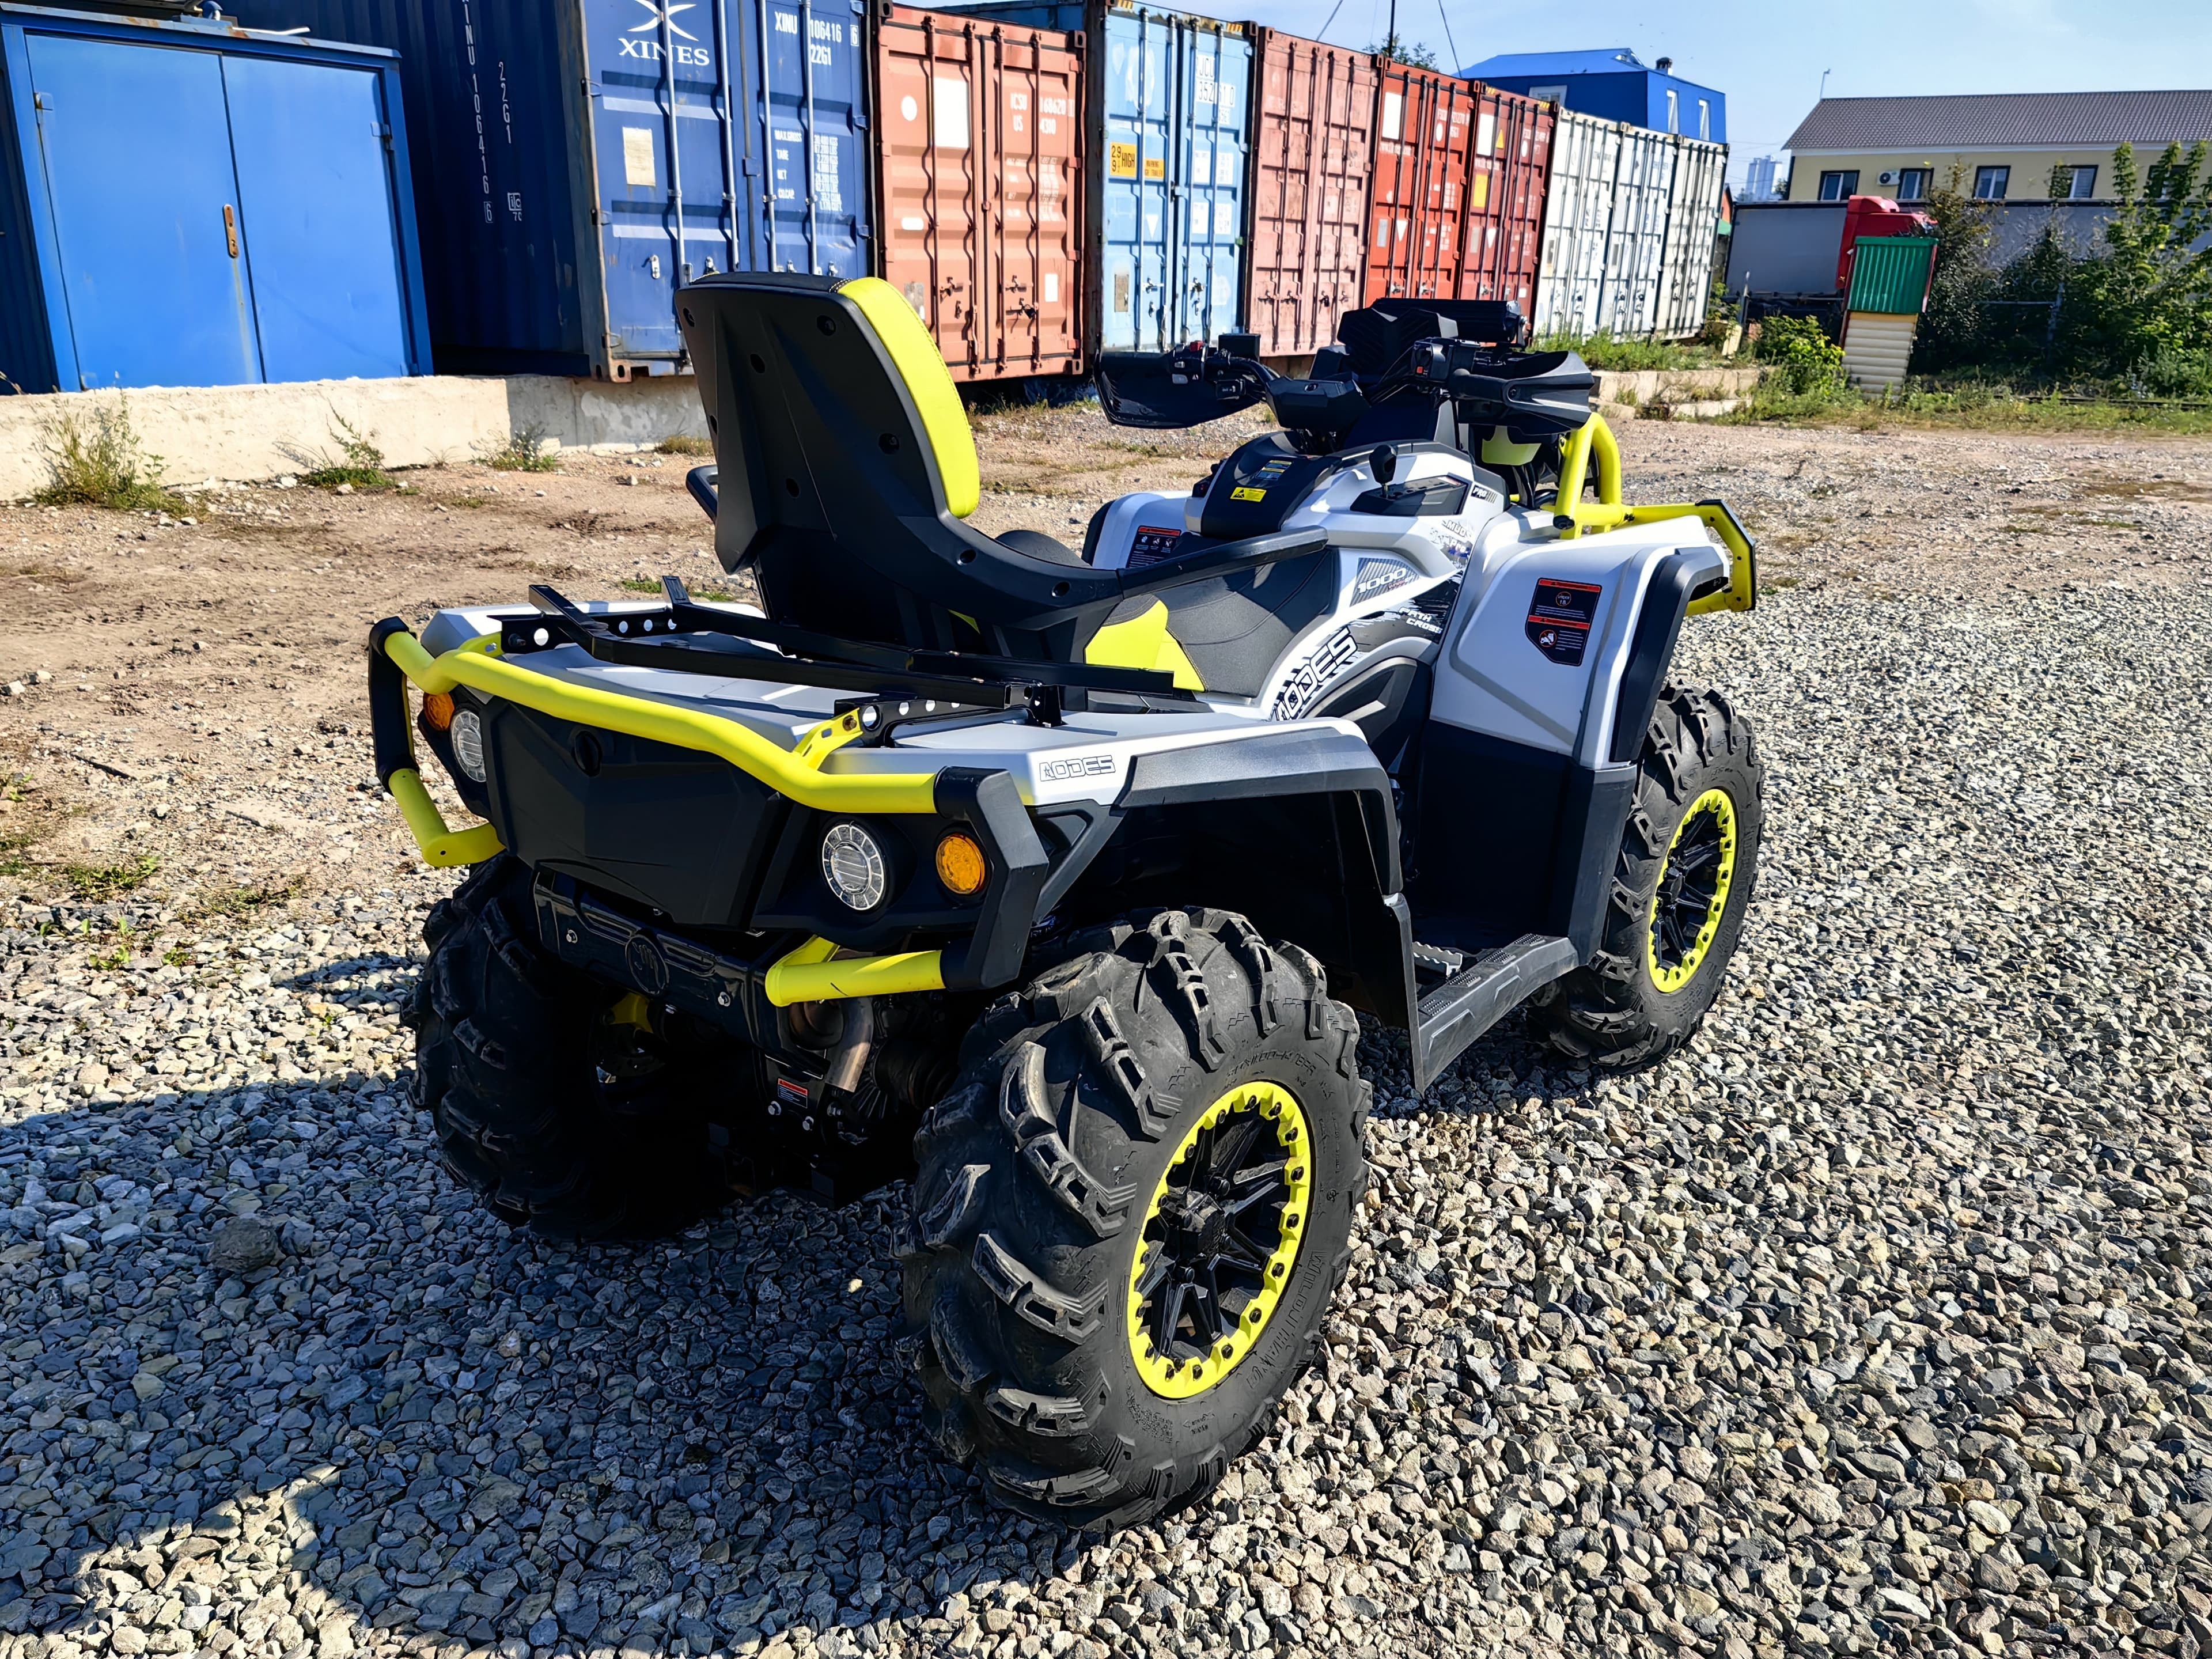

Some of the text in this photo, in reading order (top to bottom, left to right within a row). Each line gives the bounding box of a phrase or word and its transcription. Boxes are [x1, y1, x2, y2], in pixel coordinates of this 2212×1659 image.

[774, 12, 858, 45] XINU 106416 6
[618, 38, 710, 66] XINES
[810, 44, 832, 66] 22G1
[461, 0, 475, 65] INU
[472, 73, 490, 194] 106416
[499, 61, 512, 144] 22G1
[1122, 153, 1135, 168] HIGH
[1472, 487, 1487, 497] PRO
[1358, 567, 1406, 593] 1000
[1399, 607, 1432, 622] PATH
[1406, 618, 1443, 634] CROSS
[1039, 755, 1116, 782] AODES
